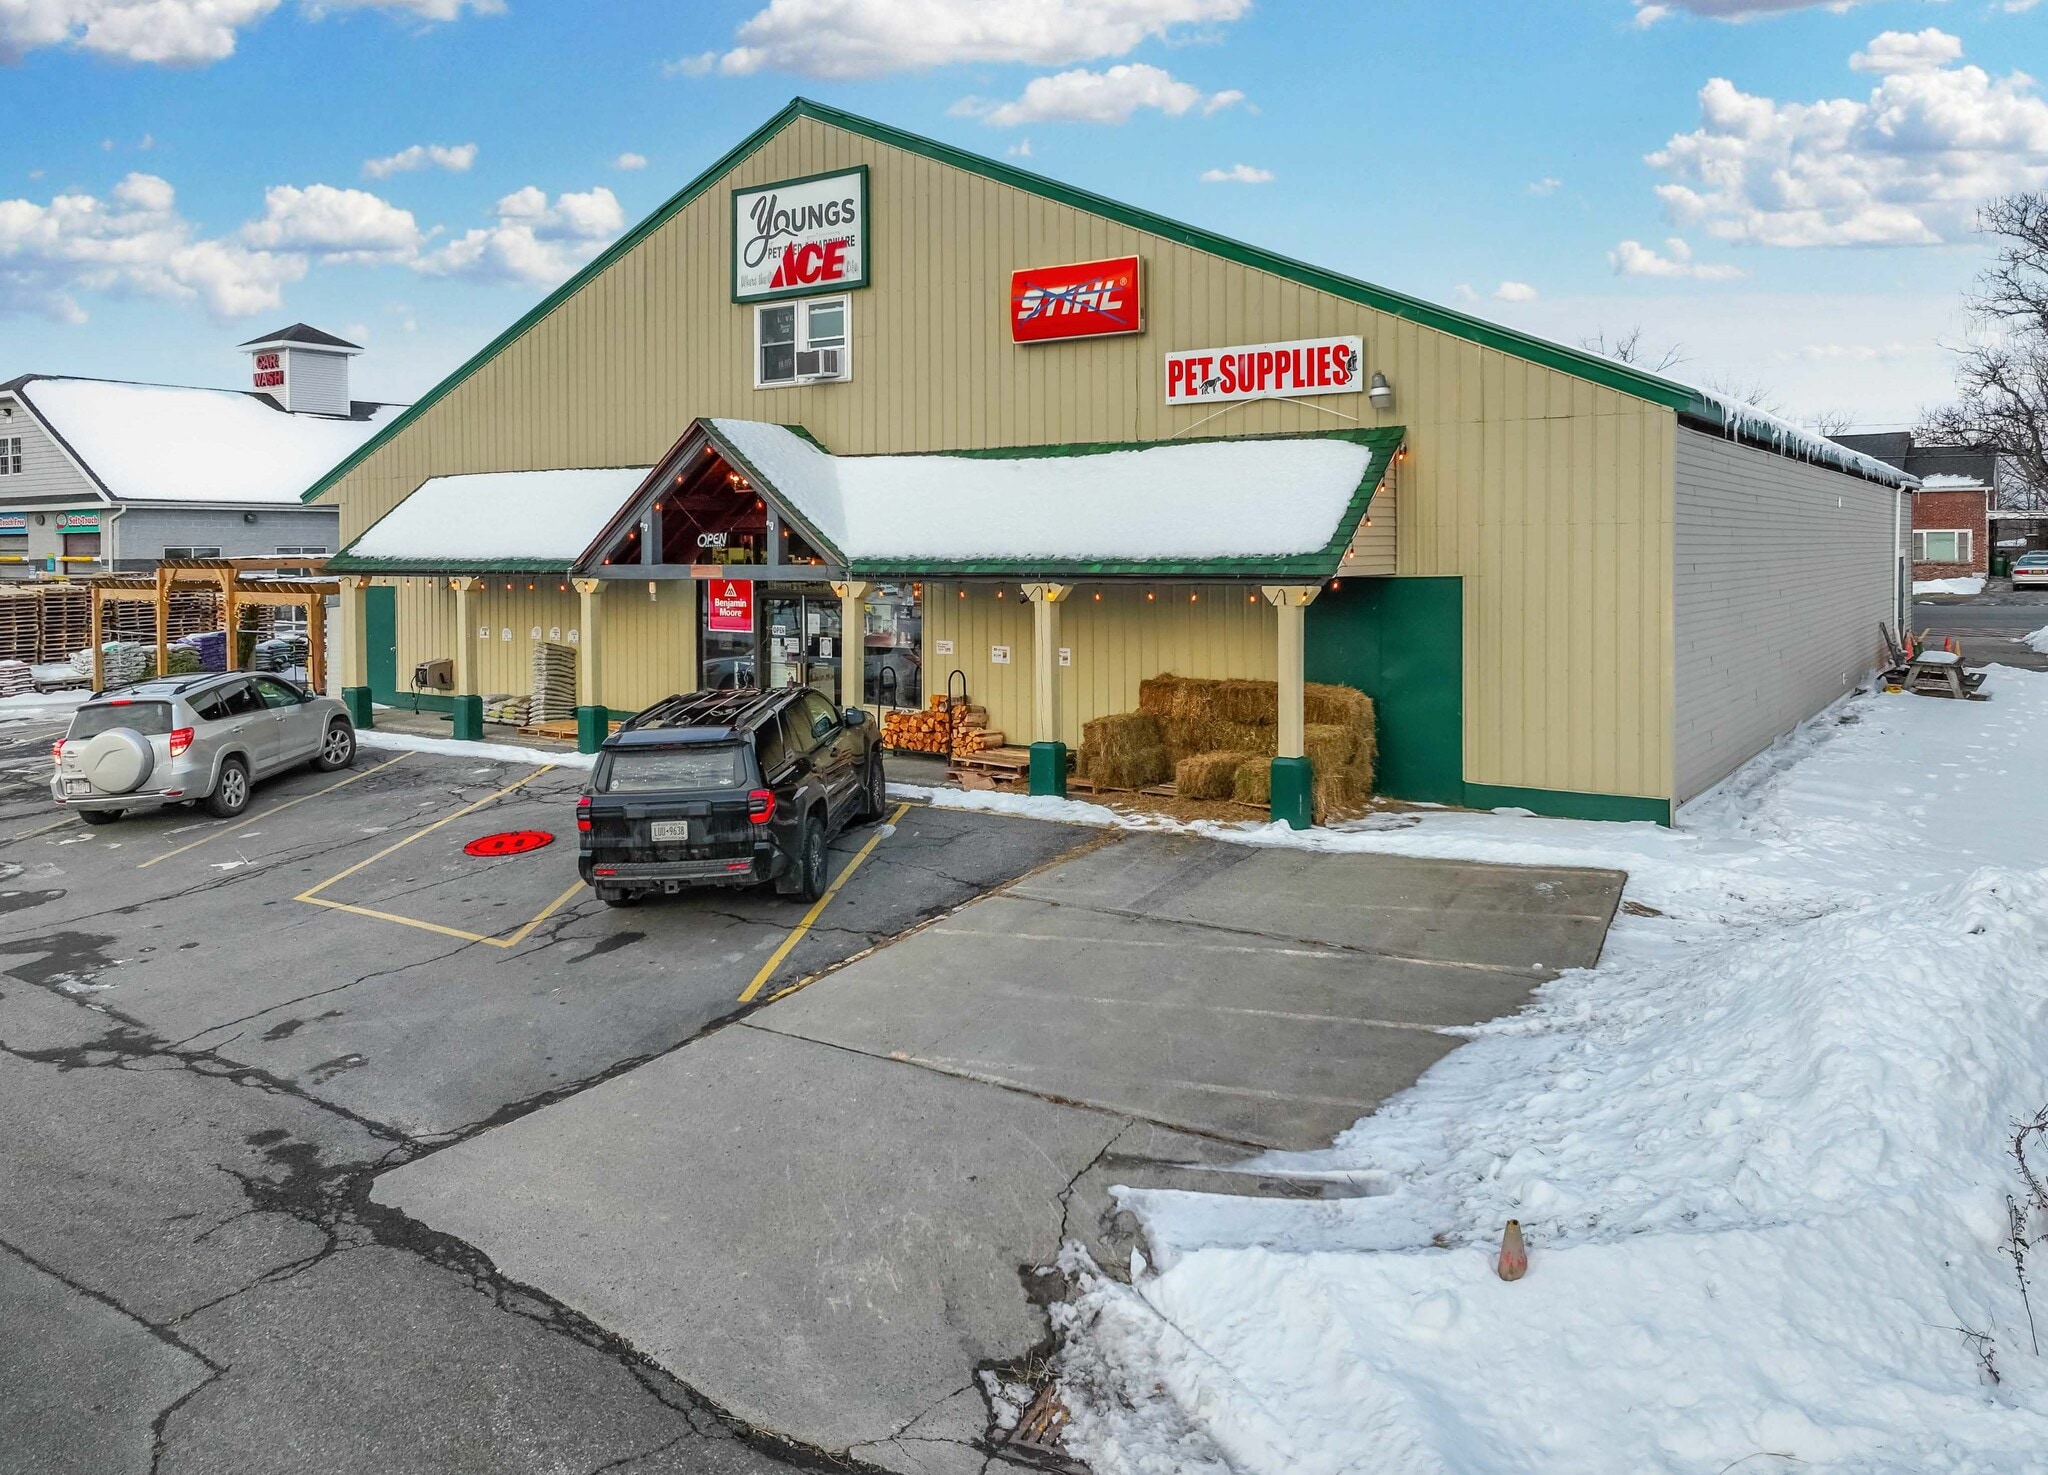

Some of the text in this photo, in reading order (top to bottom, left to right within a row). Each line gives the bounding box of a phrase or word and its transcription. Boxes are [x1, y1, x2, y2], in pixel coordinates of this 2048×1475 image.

[768, 246, 782, 259] PET
[784, 243, 803, 256] FED
[769, 241, 847, 288] ACE
[1017, 279, 1123, 319] STIHL
[256, 354, 279, 370] CAR
[253, 371, 284, 387] WASH
[1168, 344, 1351, 398] PET SUPPLIES
[697, 531, 728, 547] OPEN
[714, 598, 747, 608] Benjamin
[719, 607, 742, 617] Moore
[773, 626, 785, 634] OPEN
